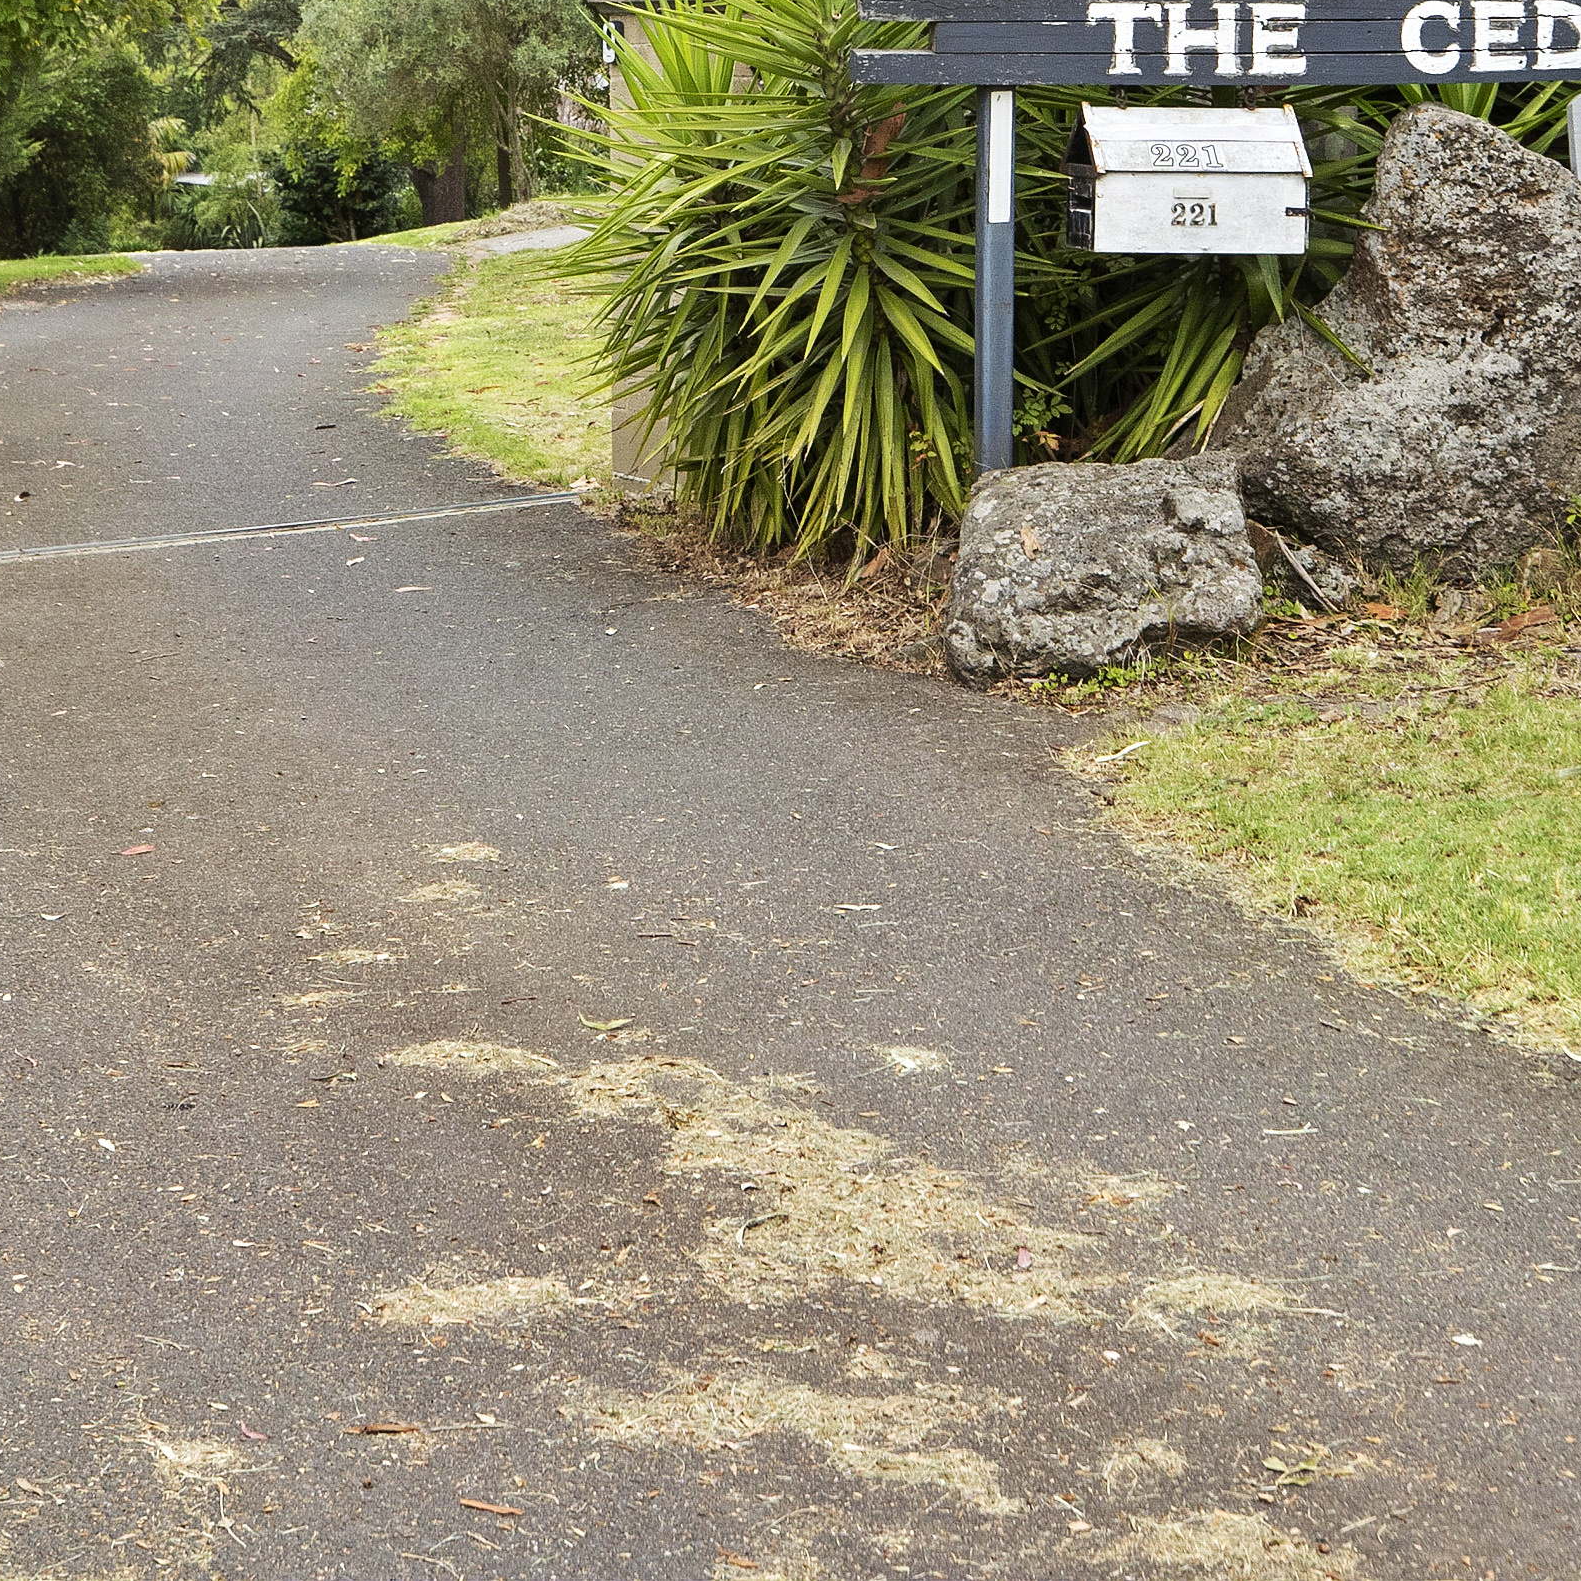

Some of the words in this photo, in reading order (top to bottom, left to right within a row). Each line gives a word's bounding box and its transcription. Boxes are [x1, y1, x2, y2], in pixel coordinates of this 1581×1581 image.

[1087, 1, 1307, 76] THE
[1150, 143, 1224, 168] 221
[1170, 202, 1218, 226] 221
